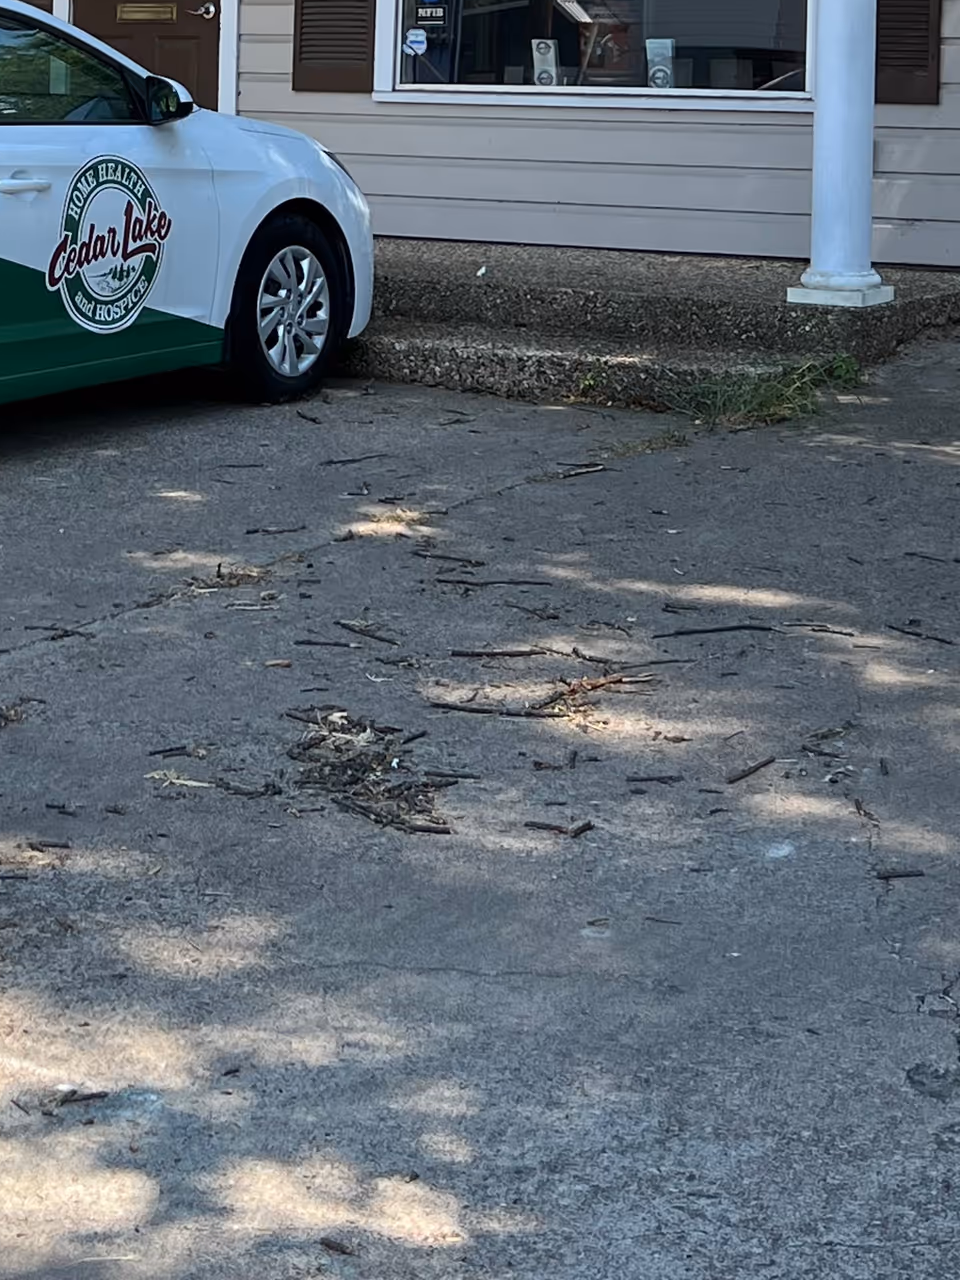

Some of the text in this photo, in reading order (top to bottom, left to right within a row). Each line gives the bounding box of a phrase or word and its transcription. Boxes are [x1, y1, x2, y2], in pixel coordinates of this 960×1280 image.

[417, 8, 444, 17] NFIB
[68, 162, 146, 221] HOME HEALTH
[48, 199, 172, 288] Cedar Lake
[74, 275, 149, 322] and HOSPICE
